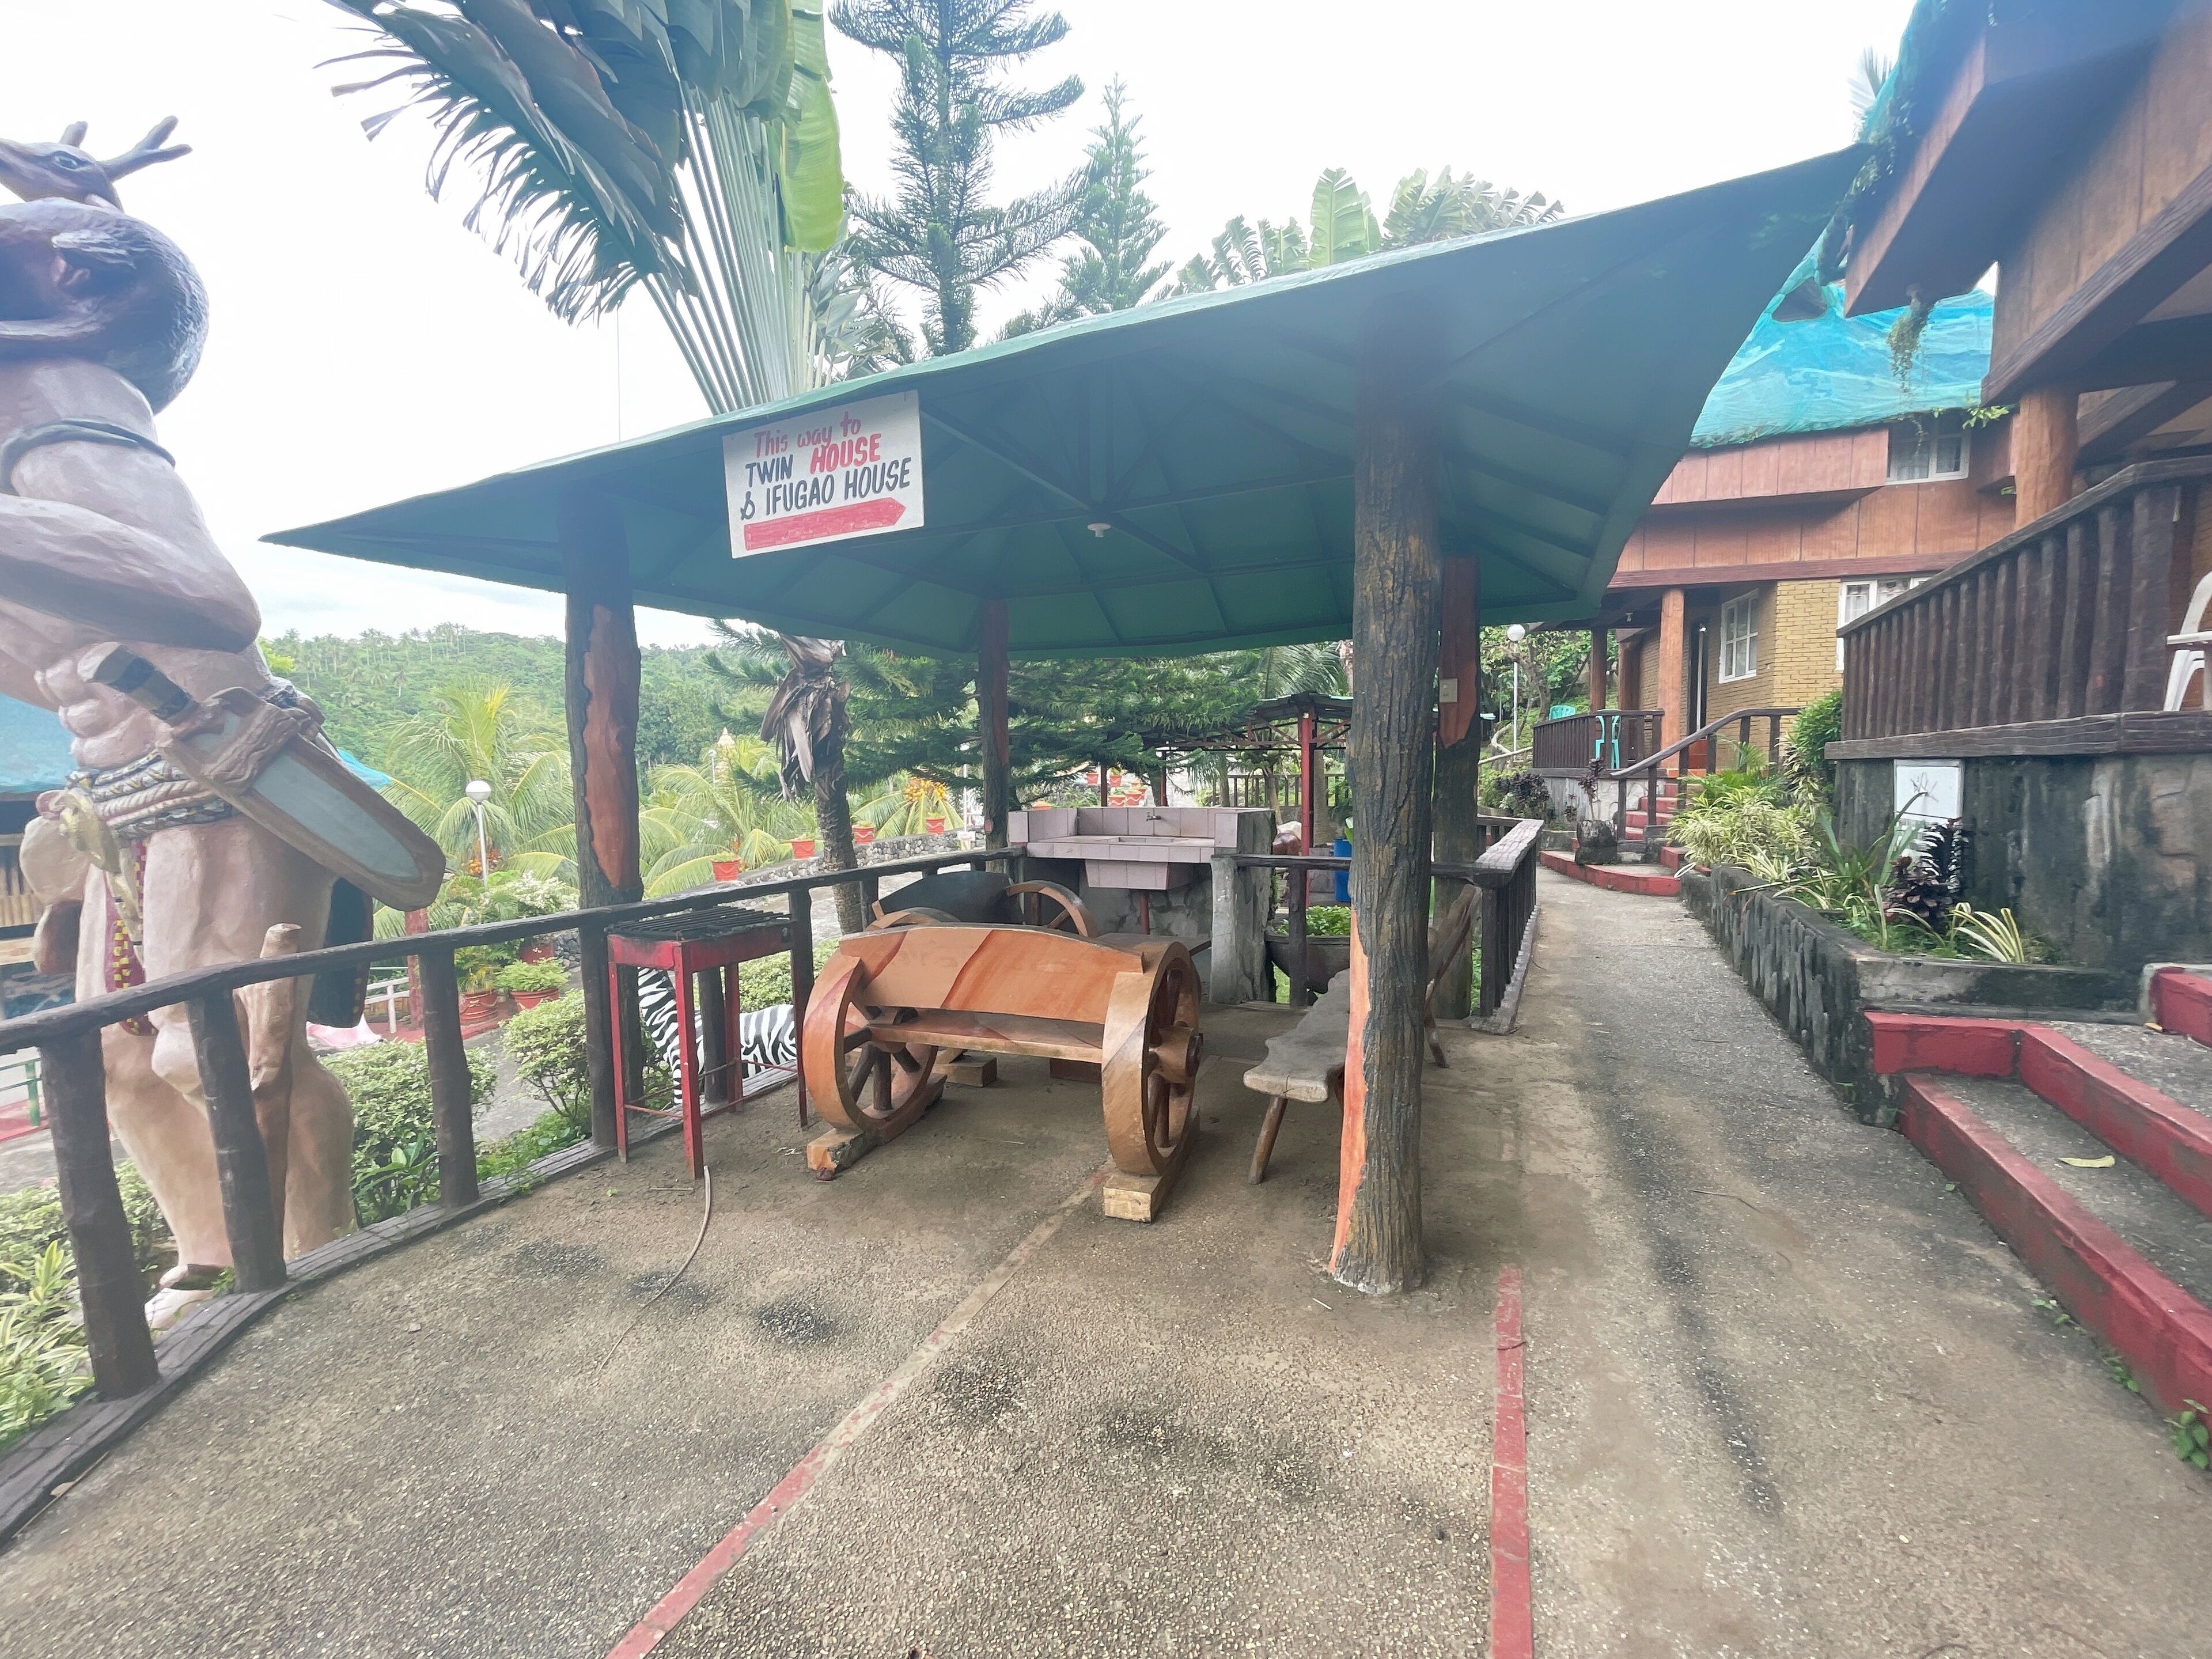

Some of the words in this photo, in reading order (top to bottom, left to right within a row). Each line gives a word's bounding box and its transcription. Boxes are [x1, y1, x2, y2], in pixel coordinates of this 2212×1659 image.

[745, 454, 793, 488] TWIN
[809, 433, 882, 474] HOUSE
[754, 429, 788, 459] This
[797, 426, 832, 451] way
[840, 411, 861, 438] to
[766, 474, 835, 516] IFUGAO
[844, 457, 912, 501] HOUSE
